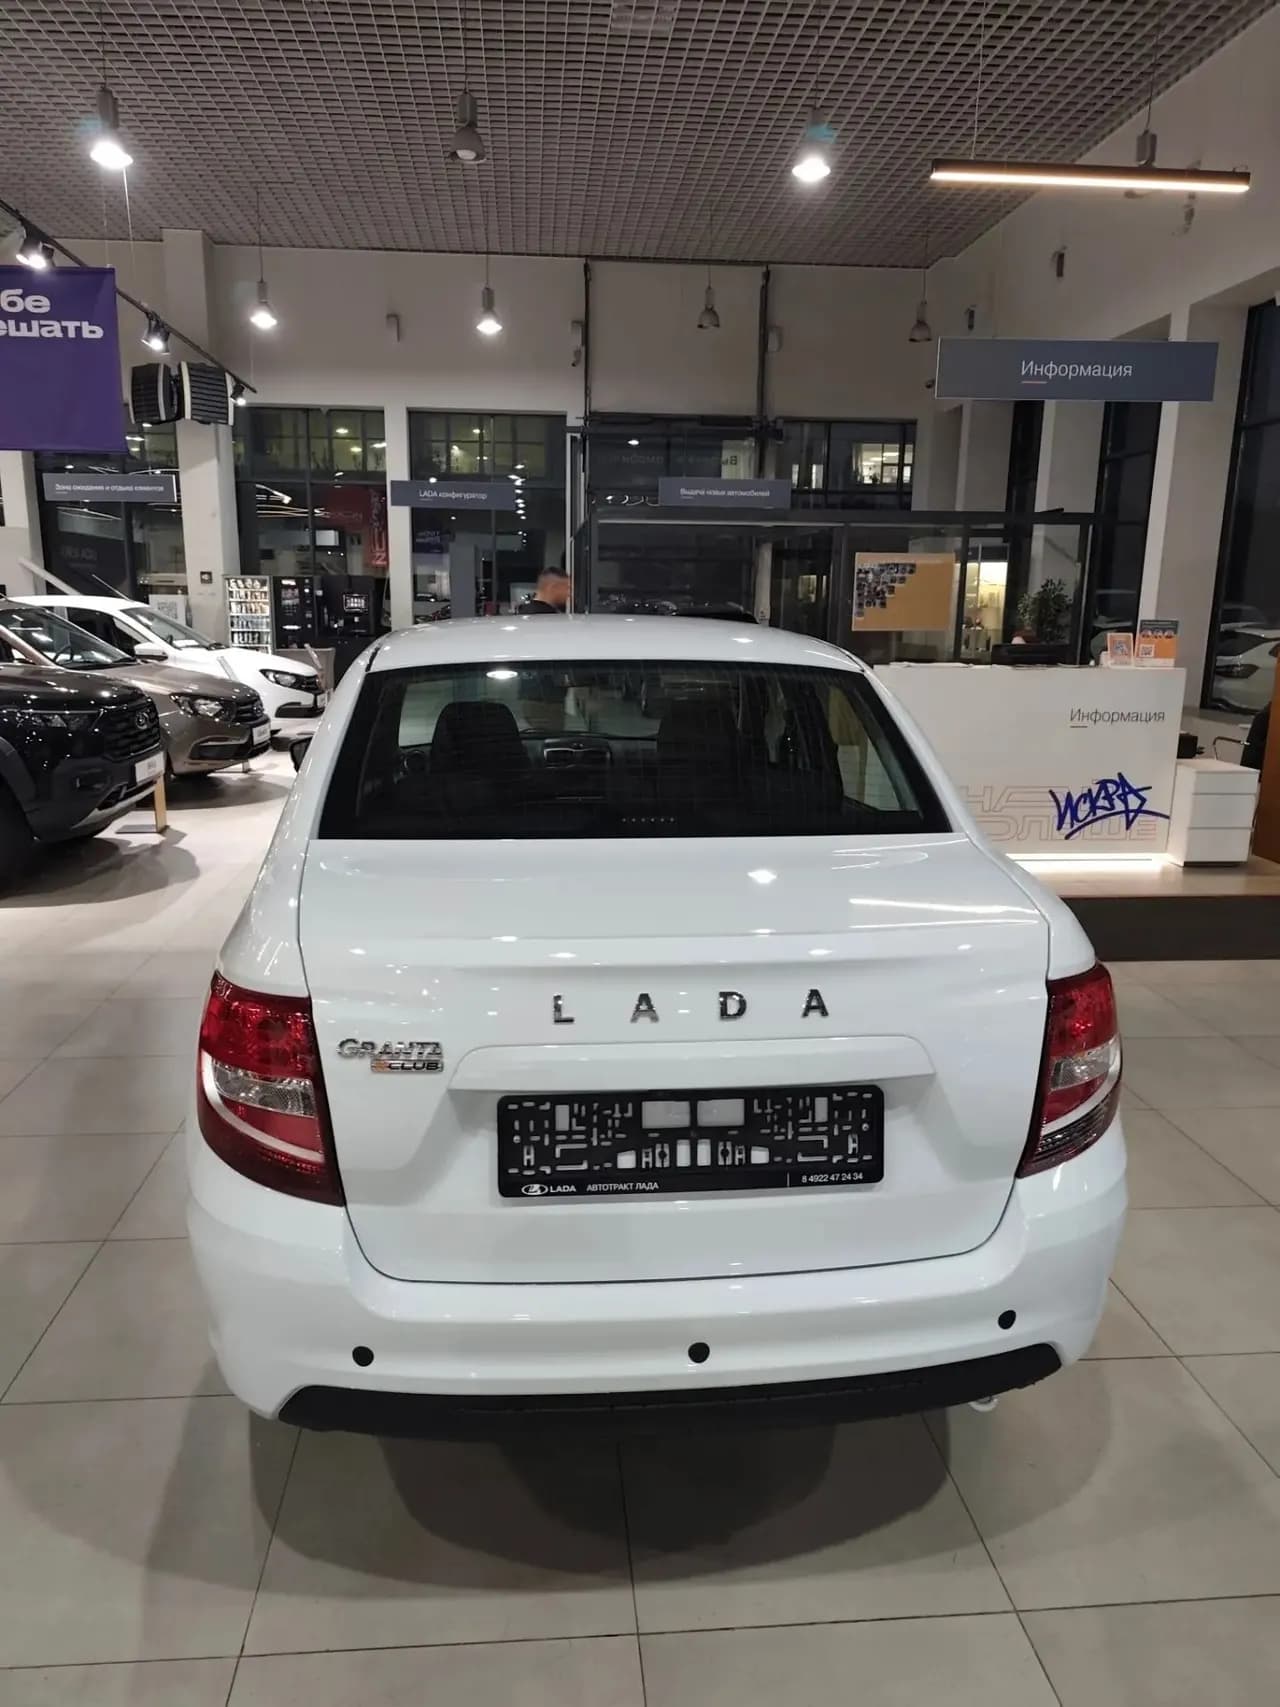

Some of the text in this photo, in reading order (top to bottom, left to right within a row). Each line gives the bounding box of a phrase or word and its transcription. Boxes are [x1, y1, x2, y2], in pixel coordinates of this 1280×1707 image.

[1020, 359, 1133, 380] Информация
[418, 489, 438, 498] LADA
[1069, 707, 1166, 725] Информация
[552, 988, 830, 1025] LADA
[801, 1171, 864, 1184] 8 4922 47 24 34
[550, 1181, 660, 1193] LADA АВТОТРАКТ ЛАДА
